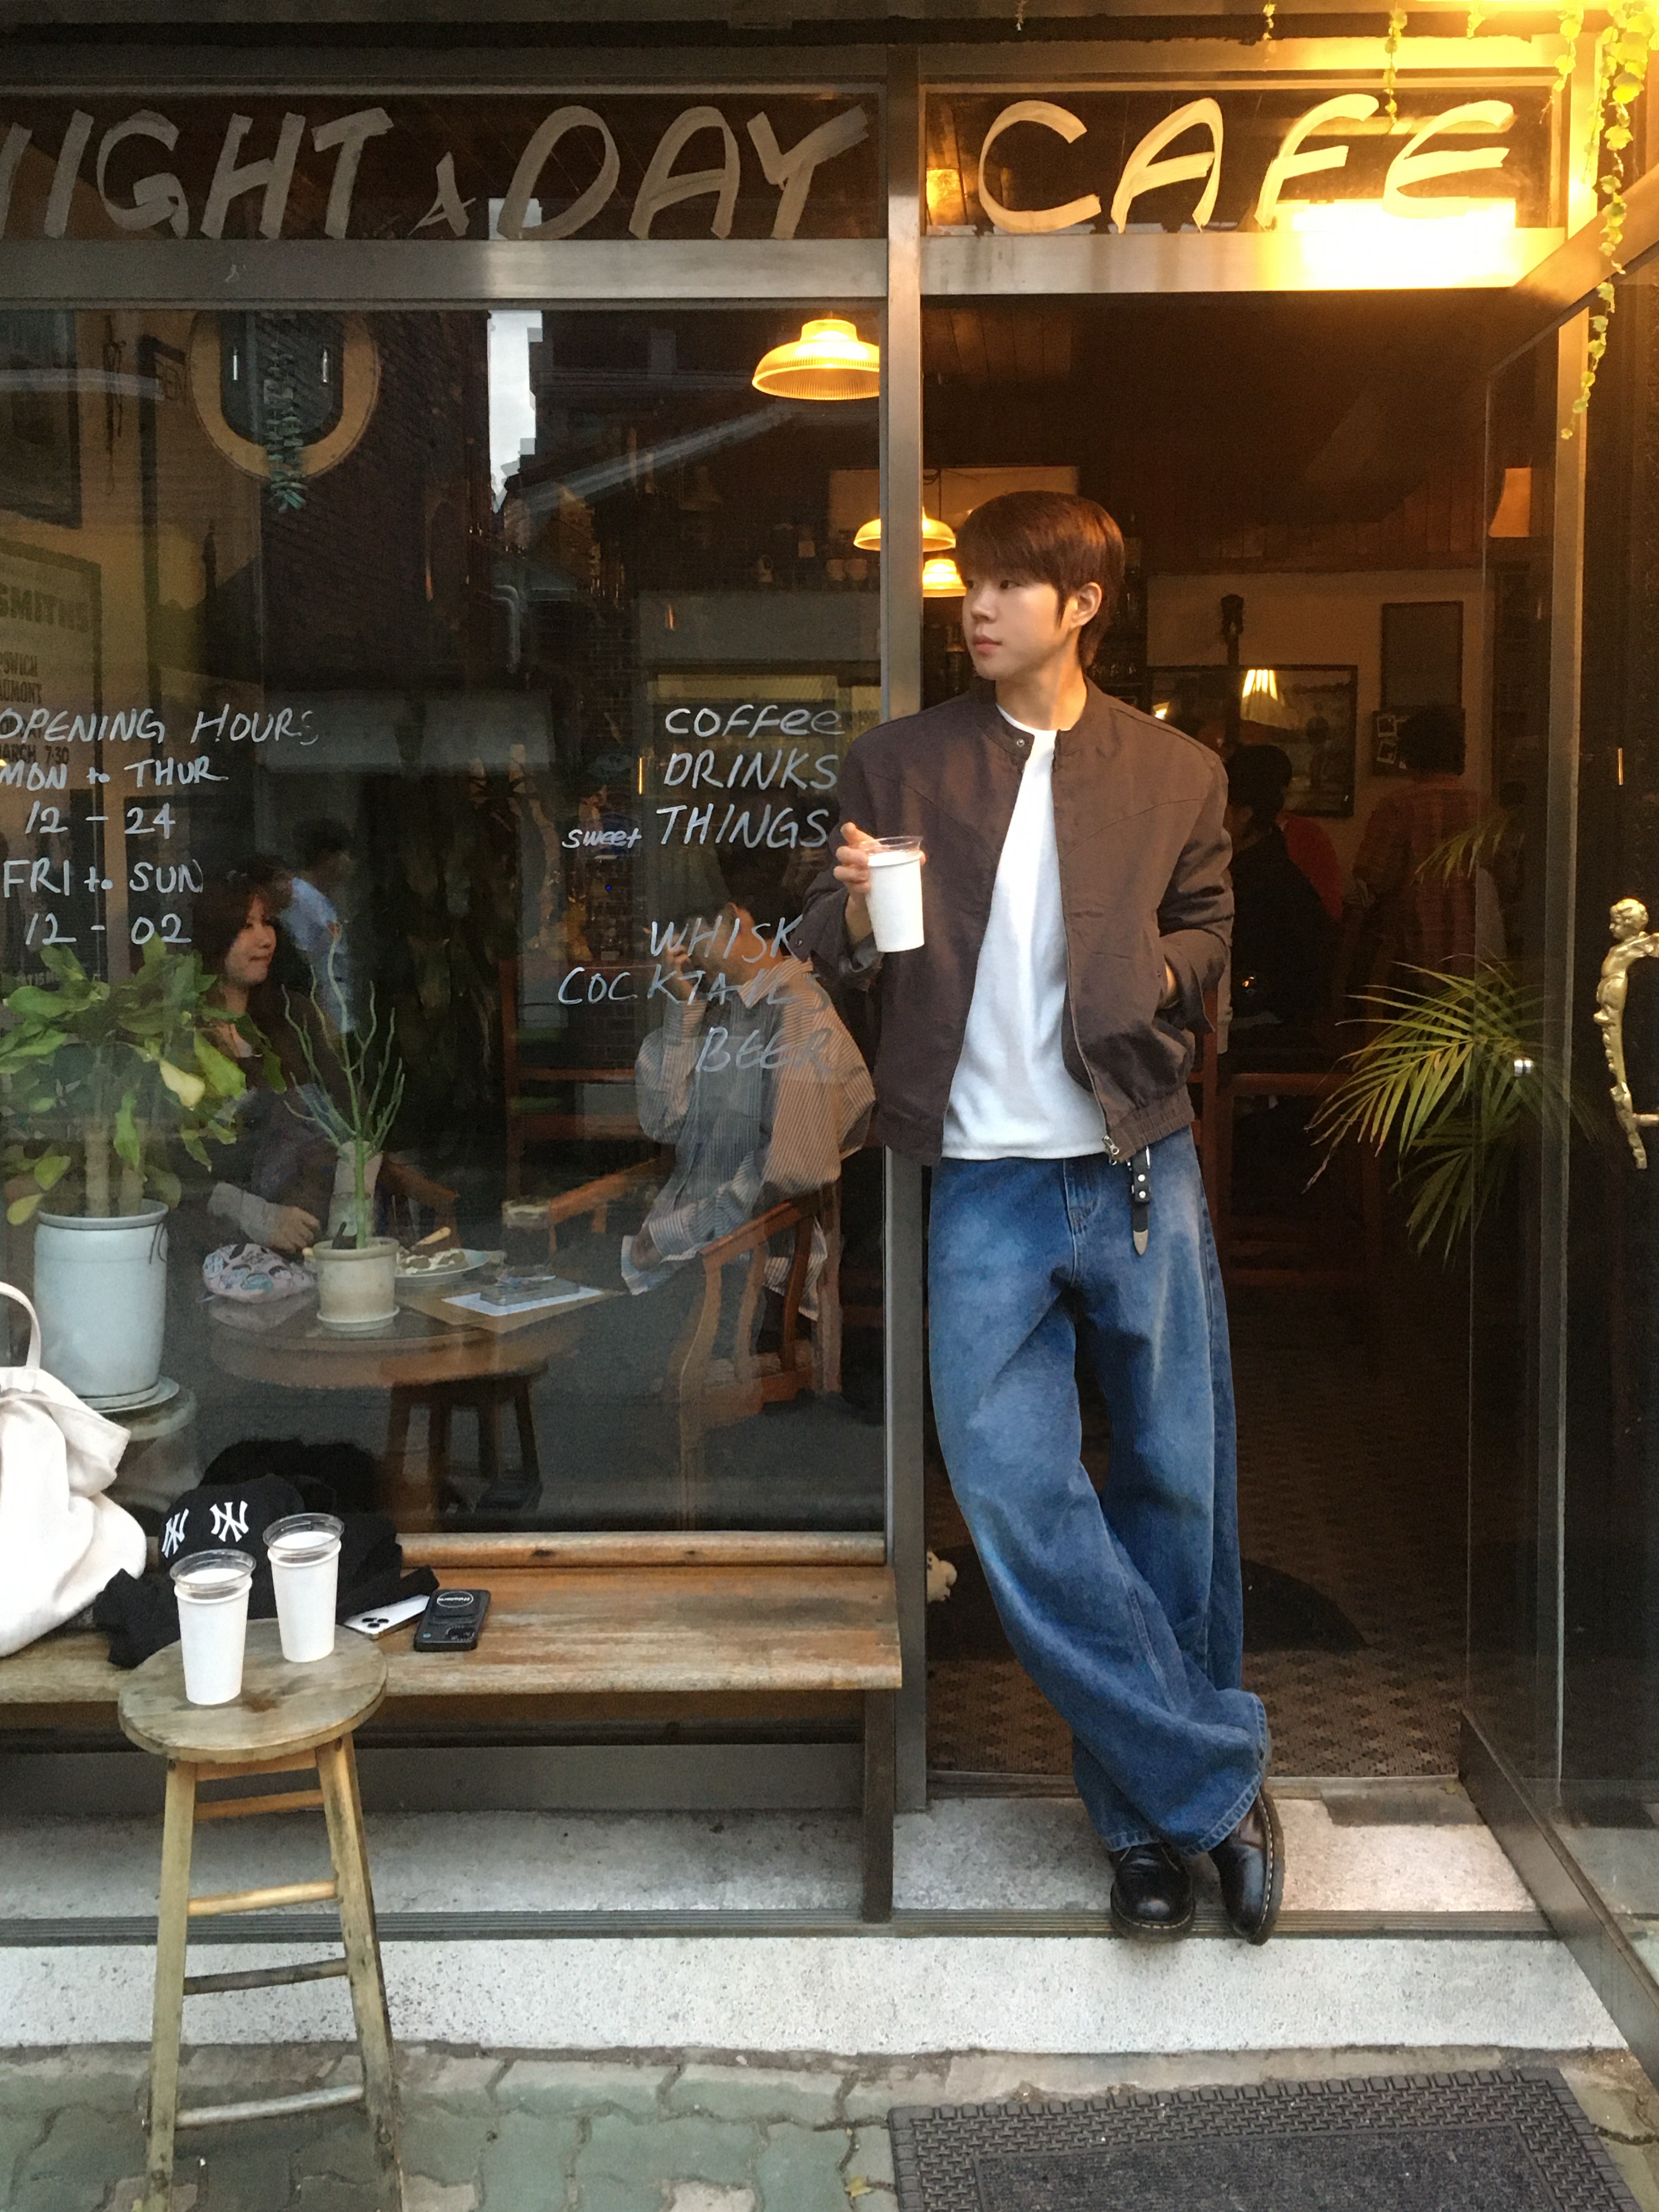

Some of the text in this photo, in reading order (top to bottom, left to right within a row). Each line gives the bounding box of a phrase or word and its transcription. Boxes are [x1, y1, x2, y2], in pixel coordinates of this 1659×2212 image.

[0, 108, 394, 239] IGHT
[496, 104, 869, 240] DAY
[978, 94, 1514, 234] CAFE
[0, 708, 165, 743] OPENING
[0, 761, 67, 790] MON
[124, 756, 229, 788] THUR
[663, 748, 839, 790] DRINKS
[25, 801, 69, 834] 12
[124, 803, 176, 839] 24
[656, 803, 830, 849] THINGS
[3, 857, 70, 898] FRI
[129, 859, 204, 893] SUN
[25, 913, 77, 945] 12
[131, 913, 191, 944] 02
